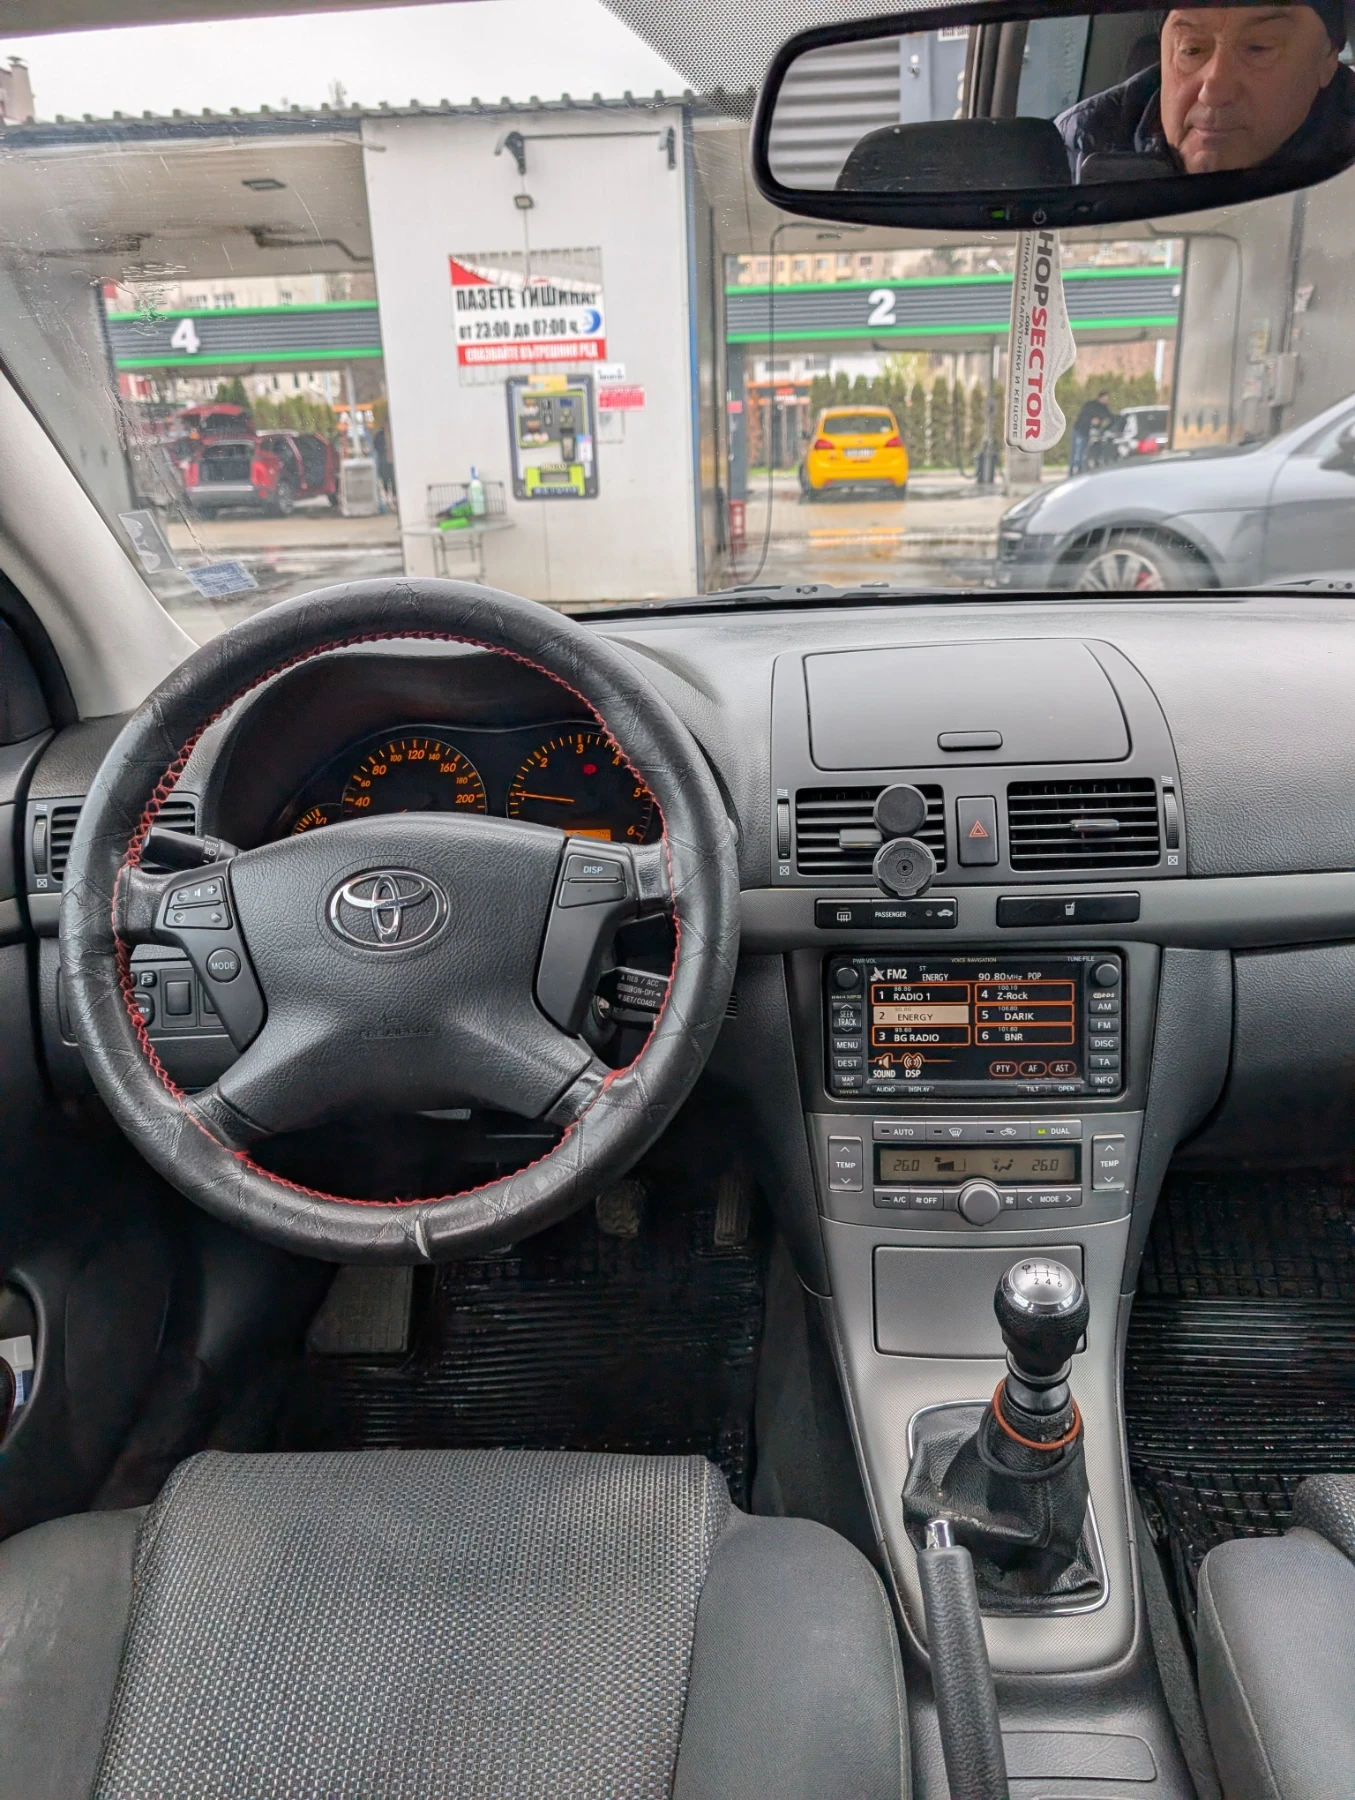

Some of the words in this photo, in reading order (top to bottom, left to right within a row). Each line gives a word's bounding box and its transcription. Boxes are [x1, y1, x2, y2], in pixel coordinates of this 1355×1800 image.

[1021, 232, 1031, 291] ИНАЛНИ
[457, 286, 517, 311] ПАЗЕТЕ
[867, 288, 897, 326] 2
[459, 324, 471, 339] от
[476, 320, 511, 339] 23:00
[513, 323, 530, 339] до
[533, 318, 567, 336] 07:00
[171, 318, 201, 354] 4
[1025, 231, 1054, 440] HOPSECTOR
[1014, 376, 1021, 384] И
[576, 744, 584, 754] 3
[390, 754, 402, 763] 100
[407, 750, 424, 760] 120
[428, 753, 440, 761] 140
[539, 758, 548, 768] 2
[612, 756, 620, 766] 4
[372, 765, 387, 775] 80
[440, 763, 457, 773] 160
[361, 780, 371, 788] 60
[456, 777, 468, 785] 180
[633, 788, 642, 798] 5
[354, 796, 371, 807] 40
[455, 793, 475, 804] 200
[627, 825, 635, 836] 6
[205, 840, 219, 848] AUTO
[583, 865, 604, 874] DISP
[211, 962, 235, 971] MODE
[887, 968, 908, 980] FM2
[922, 973, 949, 981] ENERGY
[1027, 972, 1042, 980] POP
[879, 990, 884, 1000] 1
[893, 992, 924, 1001] RADIO
[926, 992, 931, 1001] 1
[981, 990, 989, 999] 4
[996, 991, 1029, 1000] Z-Rock
[622, 994, 656, 1007] SET/COAST
[1097, 1003, 1112, 1011] AM
[839, 1010, 854, 1018] SEEK
[879, 1011, 885, 1020] 2
[897, 1013, 934, 1021] ENERGY
[981, 1010, 989, 1020] 5
[1004, 1012, 1035, 1021] DARIK
[837, 1018, 857, 1026] TRACK
[1097, 1021, 1111, 1029] FM
[878, 1031, 886, 1041] 3
[893, 1034, 908, 1042] BG
[909, 1033, 940, 1042] RADIO
[981, 1031, 989, 1040] 6
[1004, 1033, 1024, 1041] BNR
[836, 1041, 859, 1049] MENU
[1094, 1040, 1114, 1048] DISC
[837, 1059, 858, 1068] DEST
[1098, 1058, 1111, 1066] TA
[996, 1064, 1011, 1073] PTY
[1028, 1064, 1038, 1073] AF
[1055, 1064, 1070, 1072] AST
[873, 1069, 896, 1078] SOUND
[905, 1069, 921, 1078] DSP
[1094, 1076, 1114, 1084] INFO
[893, 1128, 914, 1136] AUTO
[836, 1161, 856, 1169] TEMP
[893, 1159, 920, 1172] 26.0
[1031, 1158, 1060, 1172] 26.0
[1100, 1160, 1120, 1168] TEMP
[1039, 1195, 1060, 1203] MODE
